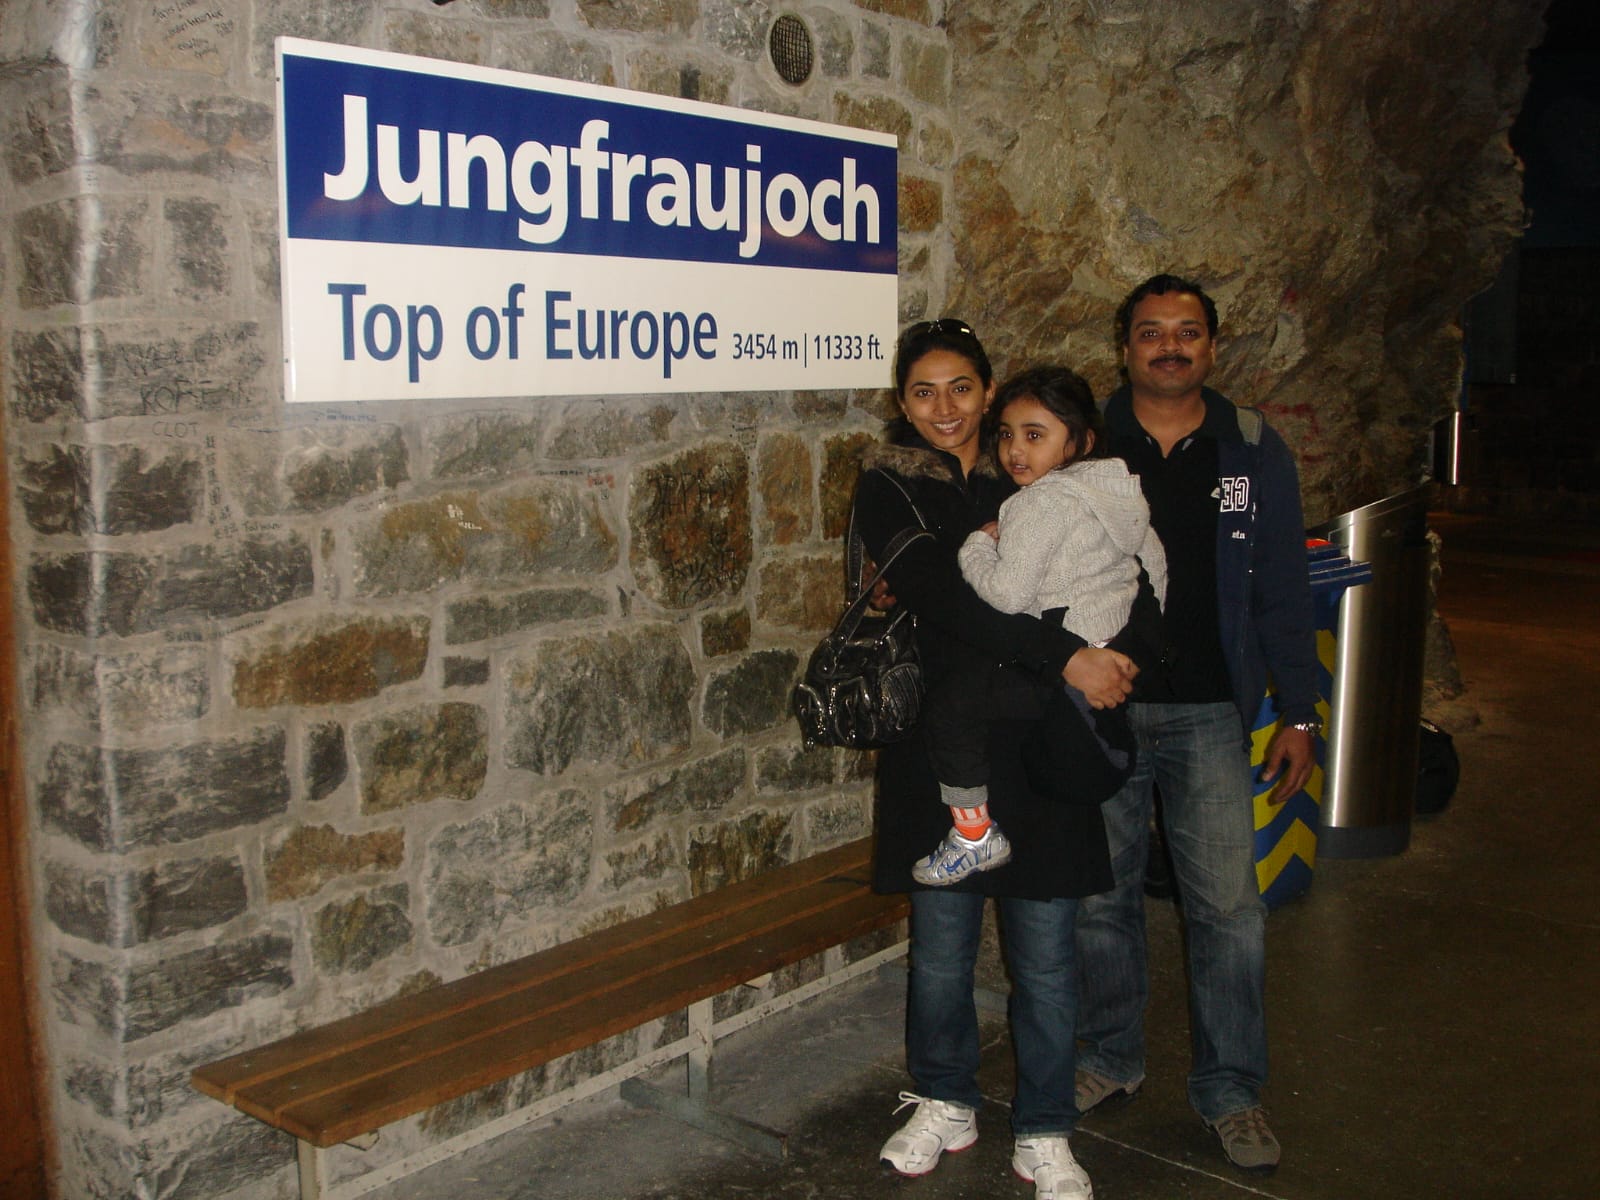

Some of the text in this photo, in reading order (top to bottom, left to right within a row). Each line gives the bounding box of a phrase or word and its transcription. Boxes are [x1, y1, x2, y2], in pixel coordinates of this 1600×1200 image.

[323, 94, 881, 258] Jungfraujoch
[327, 283, 884, 383] Top of Europe 3454 m 11333 ft.
